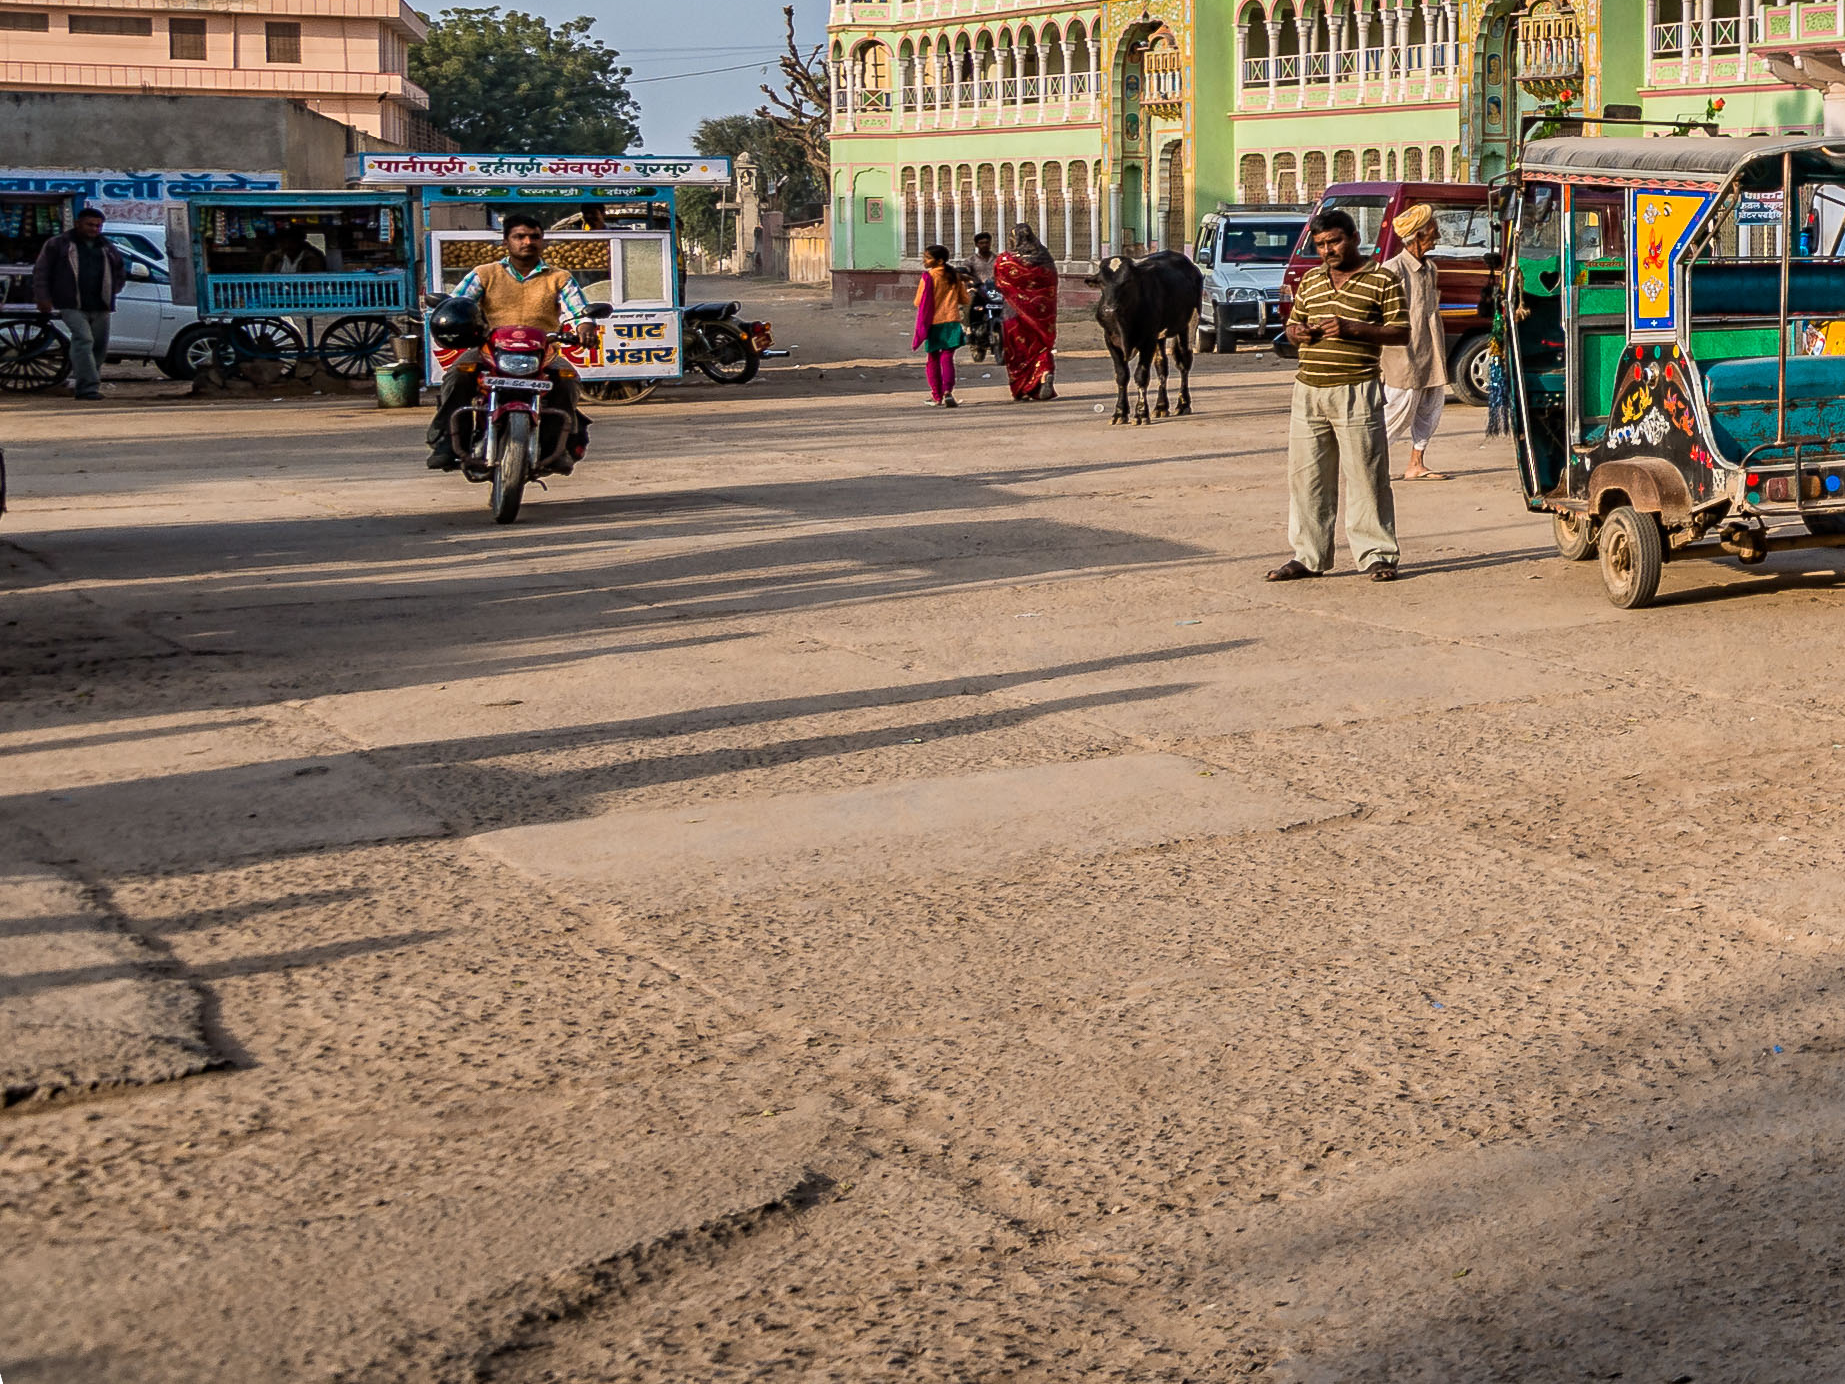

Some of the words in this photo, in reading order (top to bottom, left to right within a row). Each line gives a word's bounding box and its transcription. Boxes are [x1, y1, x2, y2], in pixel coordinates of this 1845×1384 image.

[373, 156, 467, 176] पानीपुरी
[477, 157, 543, 178] दहीपुरी
[549, 156, 620, 179] सेवपुरी
[613, 323, 667, 340] चाट
[606, 342, 677, 365] भंडार
